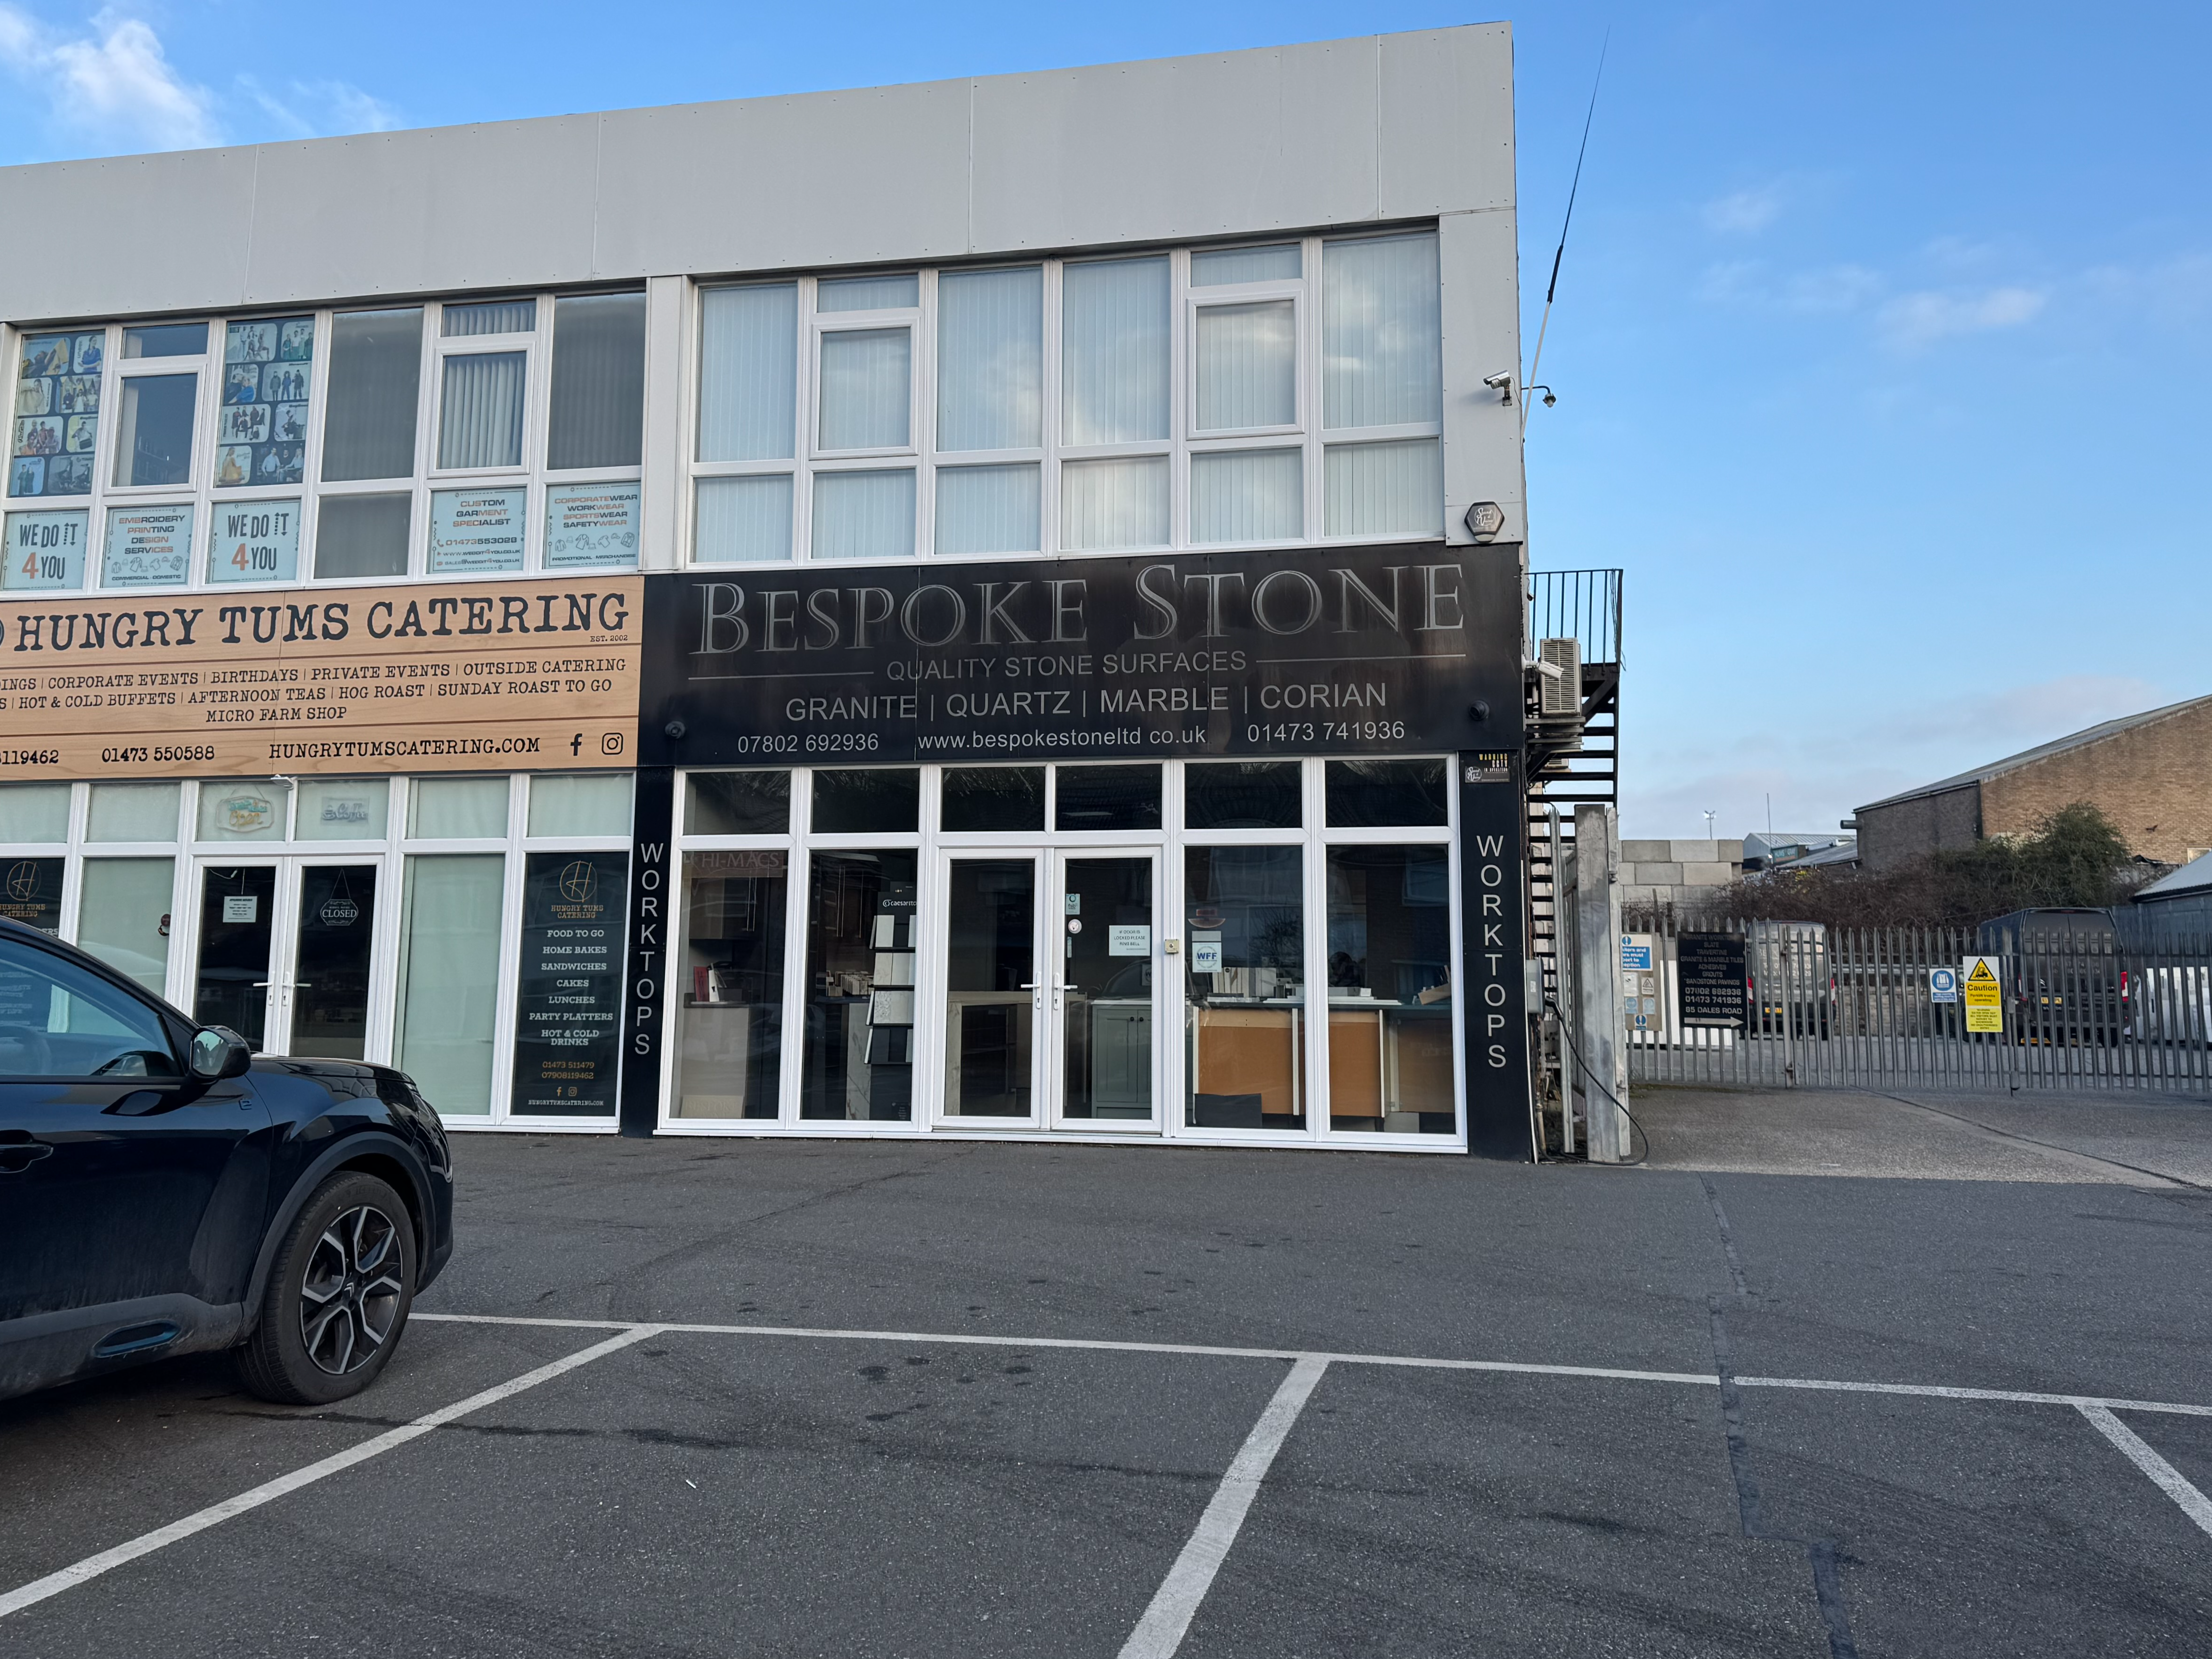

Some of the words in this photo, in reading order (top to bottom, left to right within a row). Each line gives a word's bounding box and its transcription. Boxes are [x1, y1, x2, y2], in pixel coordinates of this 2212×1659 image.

[461, 499, 505, 507] CUSTOM
[554, 494, 637, 504] CORPORATEWEAR
[567, 504, 624, 512] WORKWEAR
[119, 515, 185, 524] EMBROIDERY
[453, 519, 511, 527] SPECIALIST
[456, 509, 508, 517] GARMENT
[563, 511, 627, 520] SPORTSWEAR
[563, 520, 627, 528] SAFETYWEAR
[20, 523, 39, 547] WE
[41, 524, 59, 548] DO
[127, 525, 175, 534] PRINTING
[228, 514, 247, 538] WE
[251, 514, 269, 538] DO
[124, 546, 173, 555] SERVICES
[131, 536, 169, 545] DESIGN
[22, 552, 39, 579] 4
[41, 556, 65, 580] YOU
[231, 543, 249, 571] 4
[251, 546, 277, 571] YOU
[688, 579, 1088, 655] BESPOKE
[1134, 564, 1464, 640] STONE
[14, 608, 203, 651] HUNGRY
[219, 602, 349, 644] TUMS
[367, 593, 629, 639] CATERING
[0, 678, 36, 690] INGS
[49, 674, 133, 689] CORPORATE
[138, 672, 198, 686] EVENTS
[211, 669, 299, 683] BIRTHDAYS
[311, 666, 380, 680] PRIVATE
[385, 664, 450, 678] EVENTS
[464, 661, 537, 675] OUTSIDE
[542, 659, 626, 673] CATERING
[887, 659, 1002, 681] QUALITY
[1005, 655, 1092, 676] STONE
[1102, 650, 1246, 674] SURFACES
[19, 696, 47, 708] HOT
[51, 696, 61, 708] &
[65, 694, 103, 707] COLD
[107, 692, 176, 706] BUFFETS
[188, 689, 279, 704] AFTERNOON
[286, 688, 325, 700] TEAS
[339, 686, 369, 699] HOG
[374, 684, 424, 698] ROAST
[438, 681, 502, 696] SUNDAY
[507, 680, 560, 694] ROAST
[565, 680, 585, 693] TO
[590, 679, 612, 692] GO
[786, 695, 917, 721] GRANITE
[946, 691, 1071, 717] QUARTZ
[1100, 686, 1228, 713] MARBLE
[1260, 682, 1386, 709] CORIAN
[206, 709, 254, 723] MICRO
[259, 708, 301, 721] FARM
[307, 707, 346, 719] SHOP
[738, 735, 797, 753] 07802
[805, 733, 878, 751] 692936
[1247, 723, 1315, 742] 01473
[1323, 721, 1404, 740] 741936
[102, 748, 147, 762] 01473
[154, 746, 214, 761] 550588
[269, 738, 540, 759] HUNGRYTUMSCATERING.COM
[322, 910, 357, 918] CLOSED
[634, 843, 664, 1055] WORKTOPS
[1477, 835, 1506, 1068] WORKTOPS
